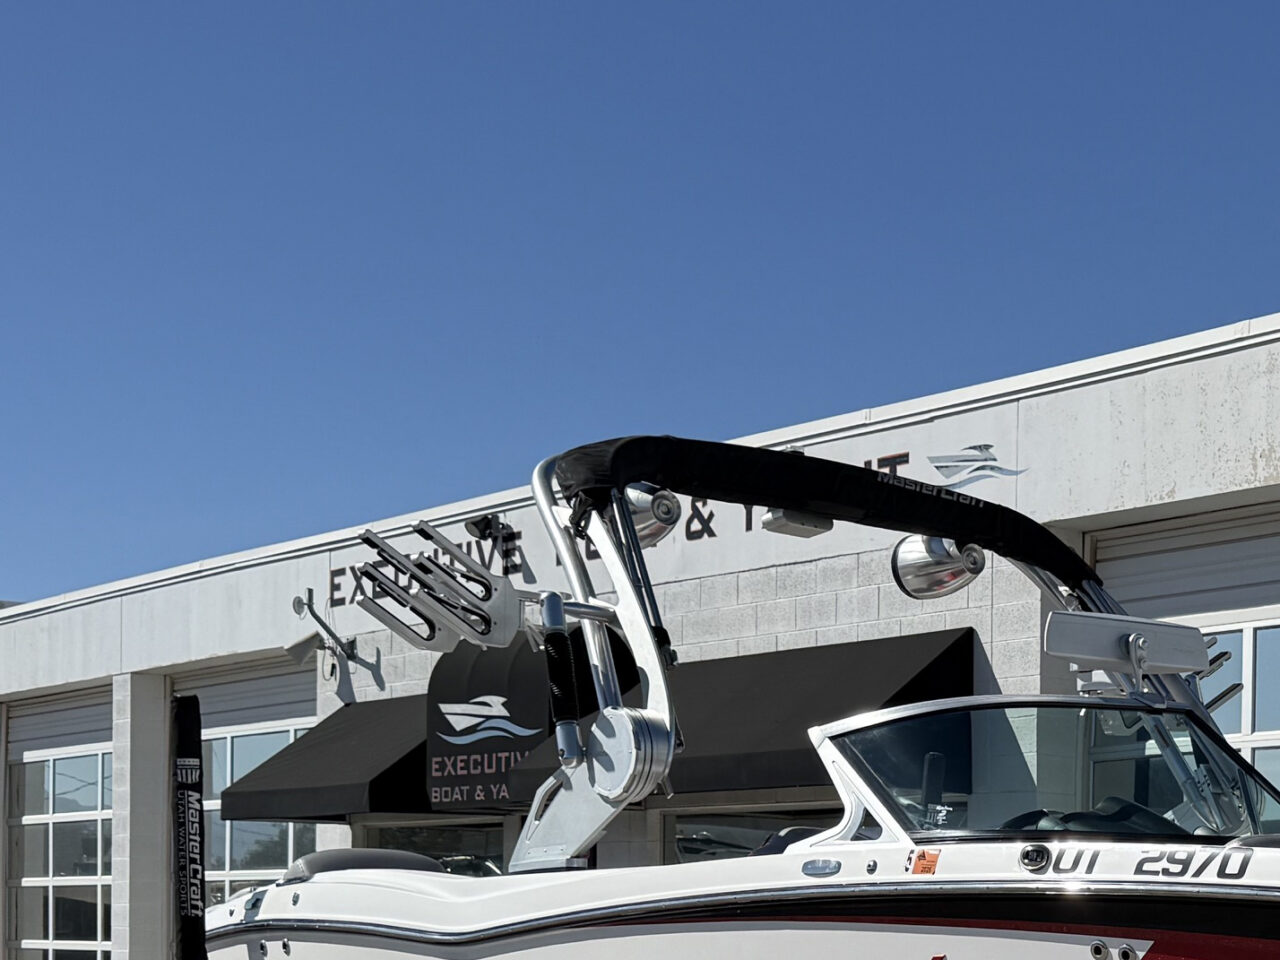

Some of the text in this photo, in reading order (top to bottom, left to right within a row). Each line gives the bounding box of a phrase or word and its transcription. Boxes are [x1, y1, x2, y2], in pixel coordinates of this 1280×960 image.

[431, 786, 470, 803] BOAT
[474, 785, 485, 801] &
[177, 790, 187, 916] UTAH WATER SPORTS
[188, 791, 203, 917] MasterCraft
[1133, 846, 1255, 880] 2970
